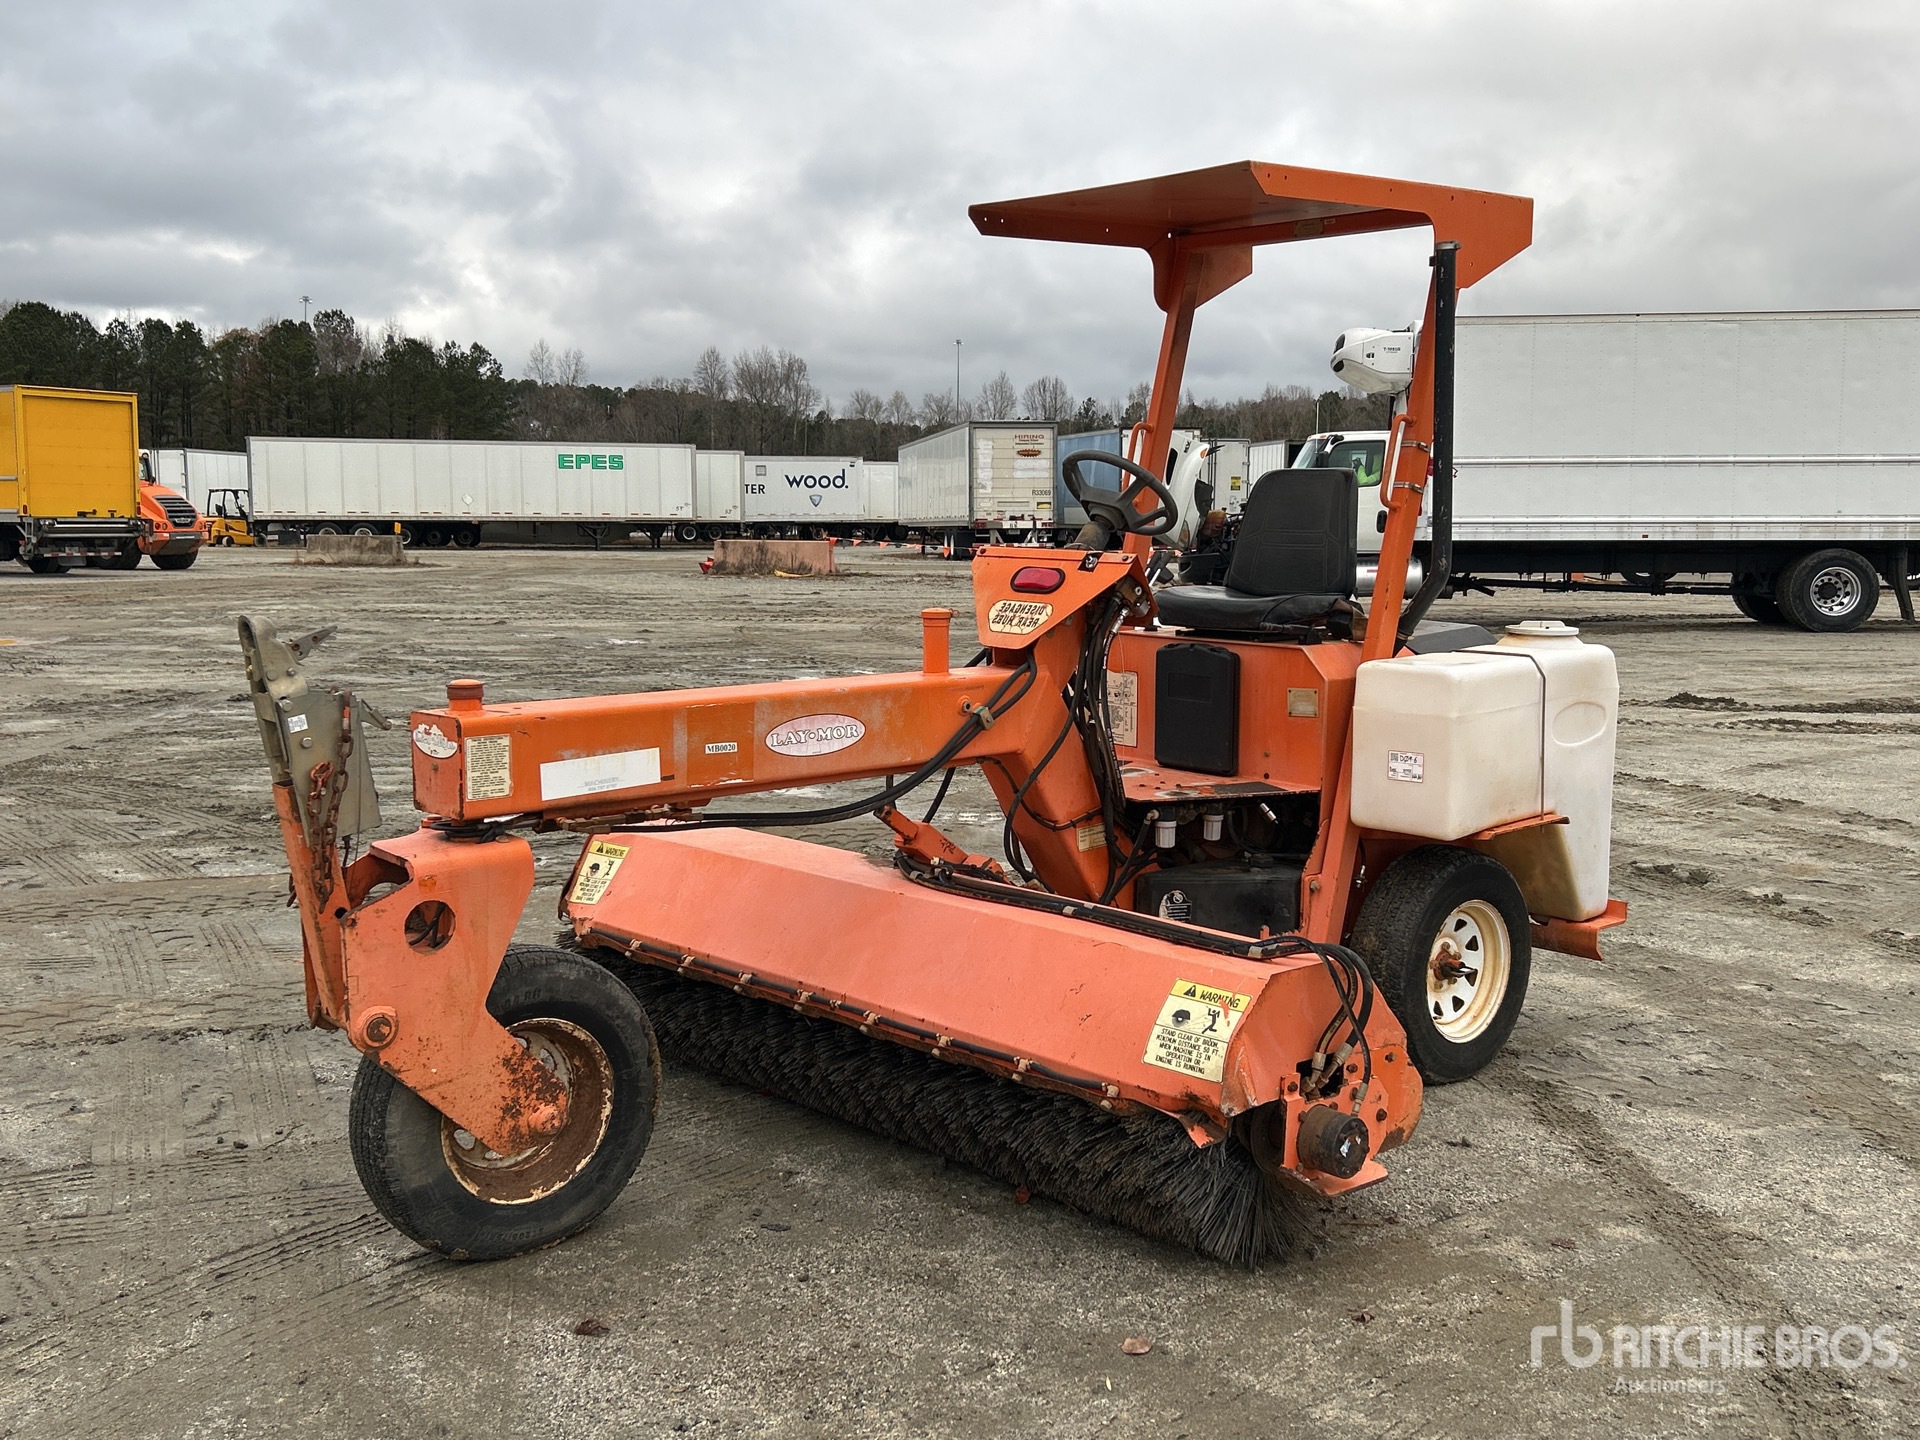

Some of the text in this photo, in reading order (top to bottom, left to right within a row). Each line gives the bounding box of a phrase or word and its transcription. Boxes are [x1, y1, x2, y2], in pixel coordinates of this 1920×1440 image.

[558, 454, 624, 470] EPES
[784, 468, 849, 489] wood.
[707, 744, 736, 753] MB0020
[1200, 990, 1240, 1009] WARNING
[1156, 1034, 1177, 1045] MINIMUM
[1178, 1040, 1201, 1051] DISTANCE
[1161, 1027, 1177, 1037] STAND
[1177, 1032, 1193, 1041] CLEAR
[1159, 1042, 1211, 1062] WHEN MACHINE IS IN
[1165, 1050, 1192, 1063] OPERATION
[1155, 1055, 1205, 1075] ENGINE IS RUNNING
